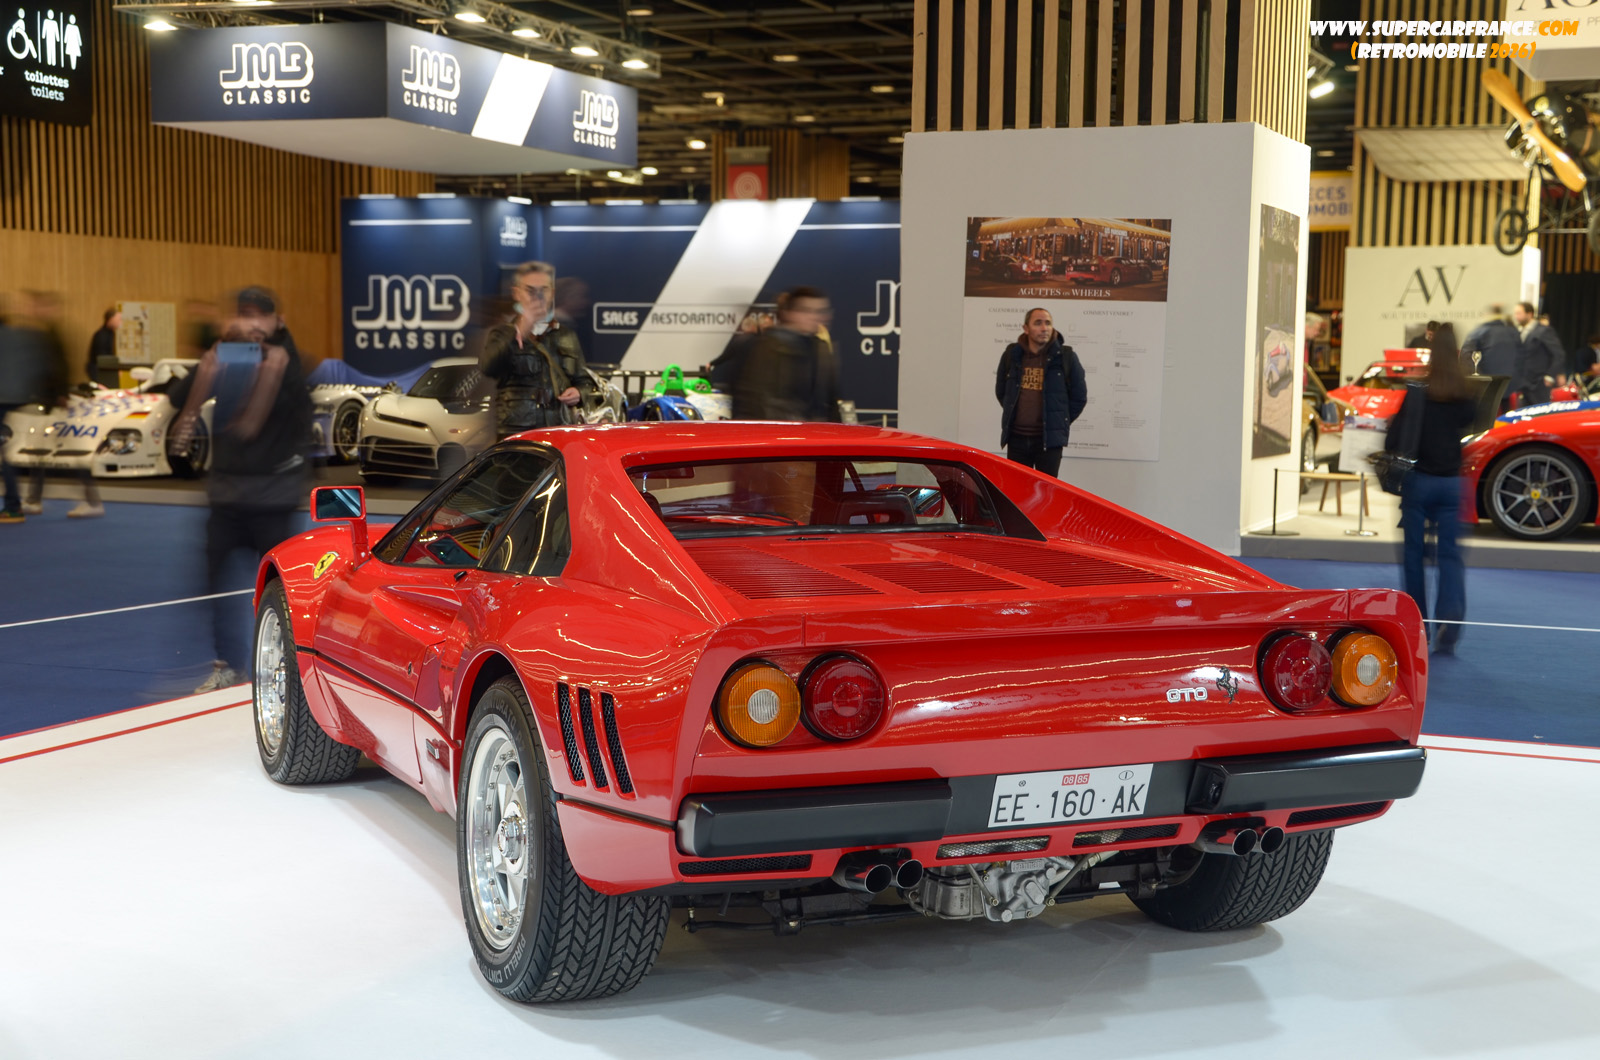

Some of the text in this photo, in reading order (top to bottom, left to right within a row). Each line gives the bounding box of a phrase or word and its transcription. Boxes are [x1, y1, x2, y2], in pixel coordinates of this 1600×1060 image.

[219, 42, 314, 89] JMB
[402, 45, 461, 100] JMB
[24, 70, 69, 89] toilettes
[31, 85, 65, 101] toilets
[223, 89, 311, 105] CLASSIC
[404, 91, 457, 116] CLASSIC
[573, 89, 619, 136] JMB
[573, 129, 616, 150] CLASSIC
[1018, 287, 1061, 297] AGUTTES
[1072, 288, 1111, 298] WHEELS
[1396, 264, 1469, 308] AW
[352, 274, 471, 330] JMB
[601, 311, 639, 326] SALES
[651, 312, 736, 326] RESTORATION
[355, 331, 465, 350] CLASSIC
[44, 421, 98, 438] FINA
[1166, 686, 1208, 703] GTO
[1063, 774, 1089, 785] 08 85
[503, 933, 527, 980] PIRELLI
